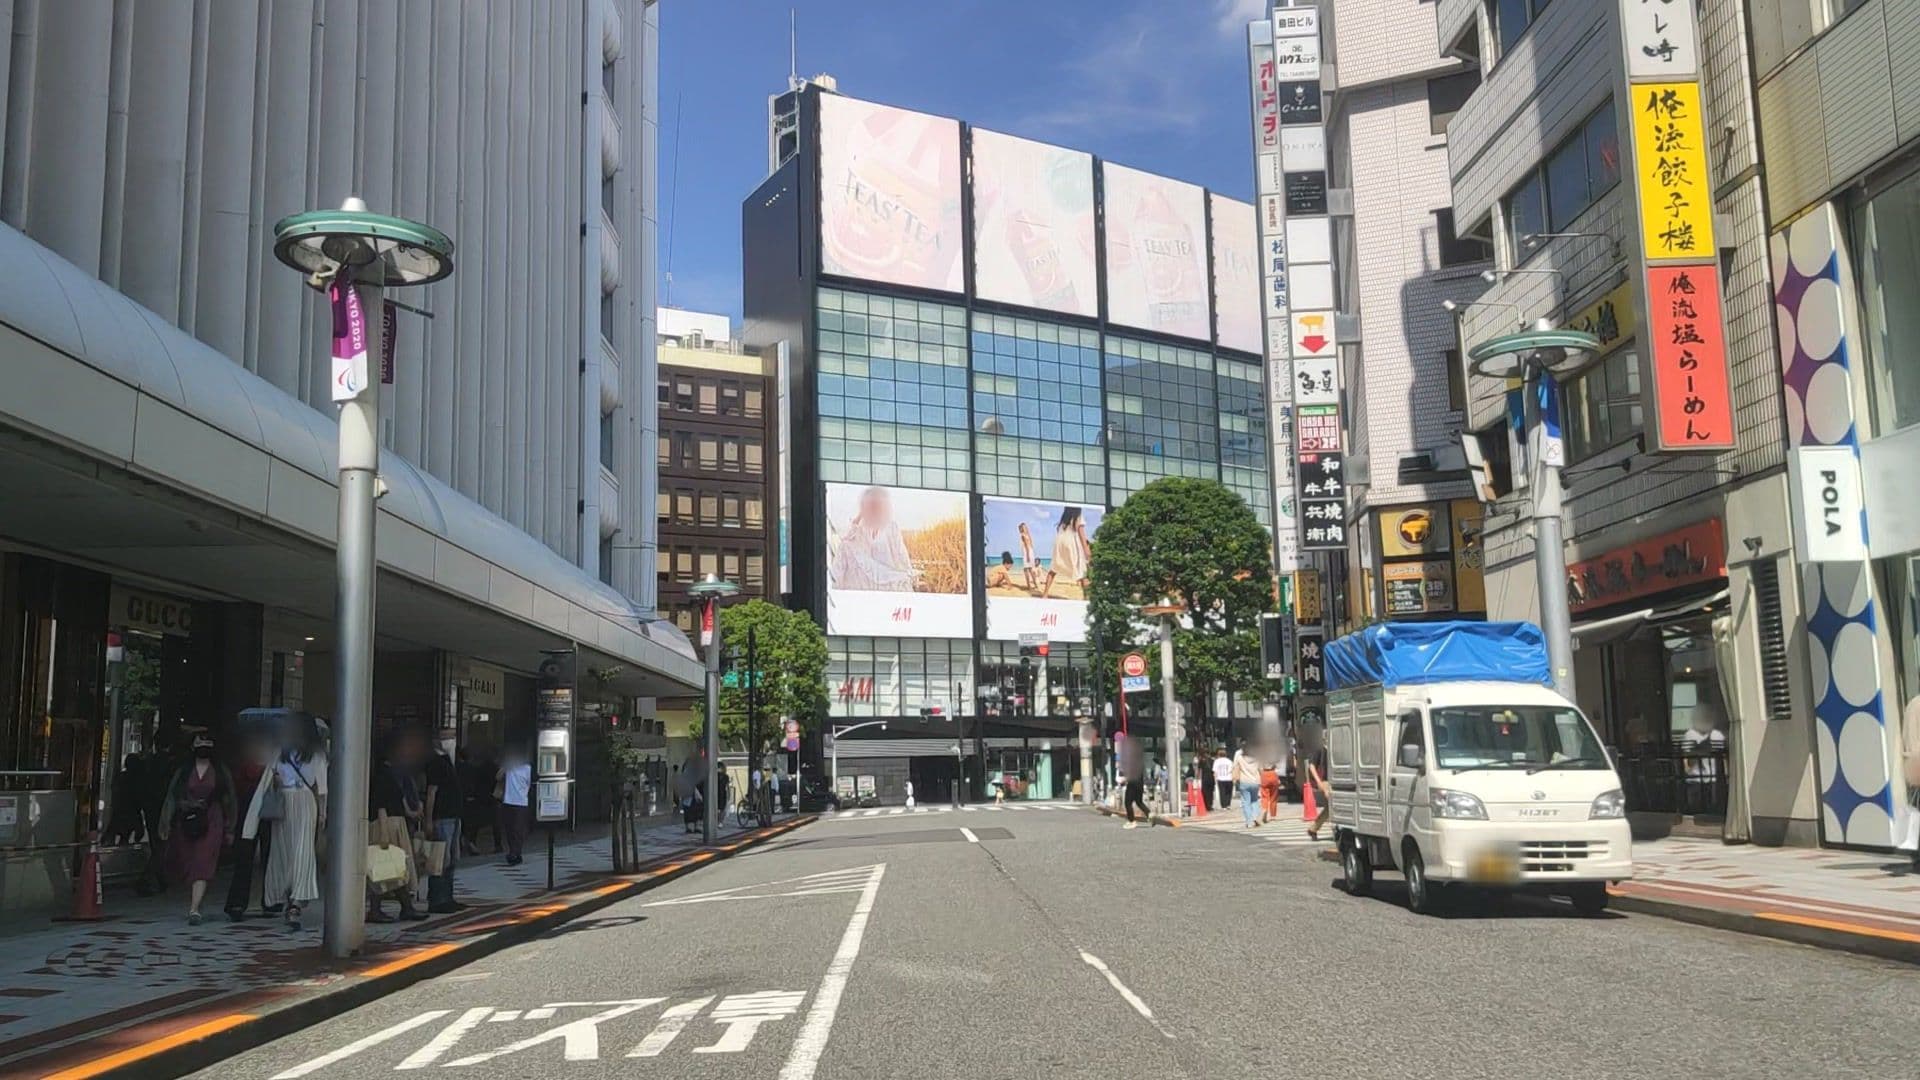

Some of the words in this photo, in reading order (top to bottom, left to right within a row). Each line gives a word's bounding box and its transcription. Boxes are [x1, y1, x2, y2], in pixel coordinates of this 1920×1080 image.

[351, 320, 361, 350] 2020
[1667, 271, 1711, 441] 俺流塩らーめん
[1819, 469, 1842, 538] POLA
[1301, 641, 1321, 683] 焼肉
